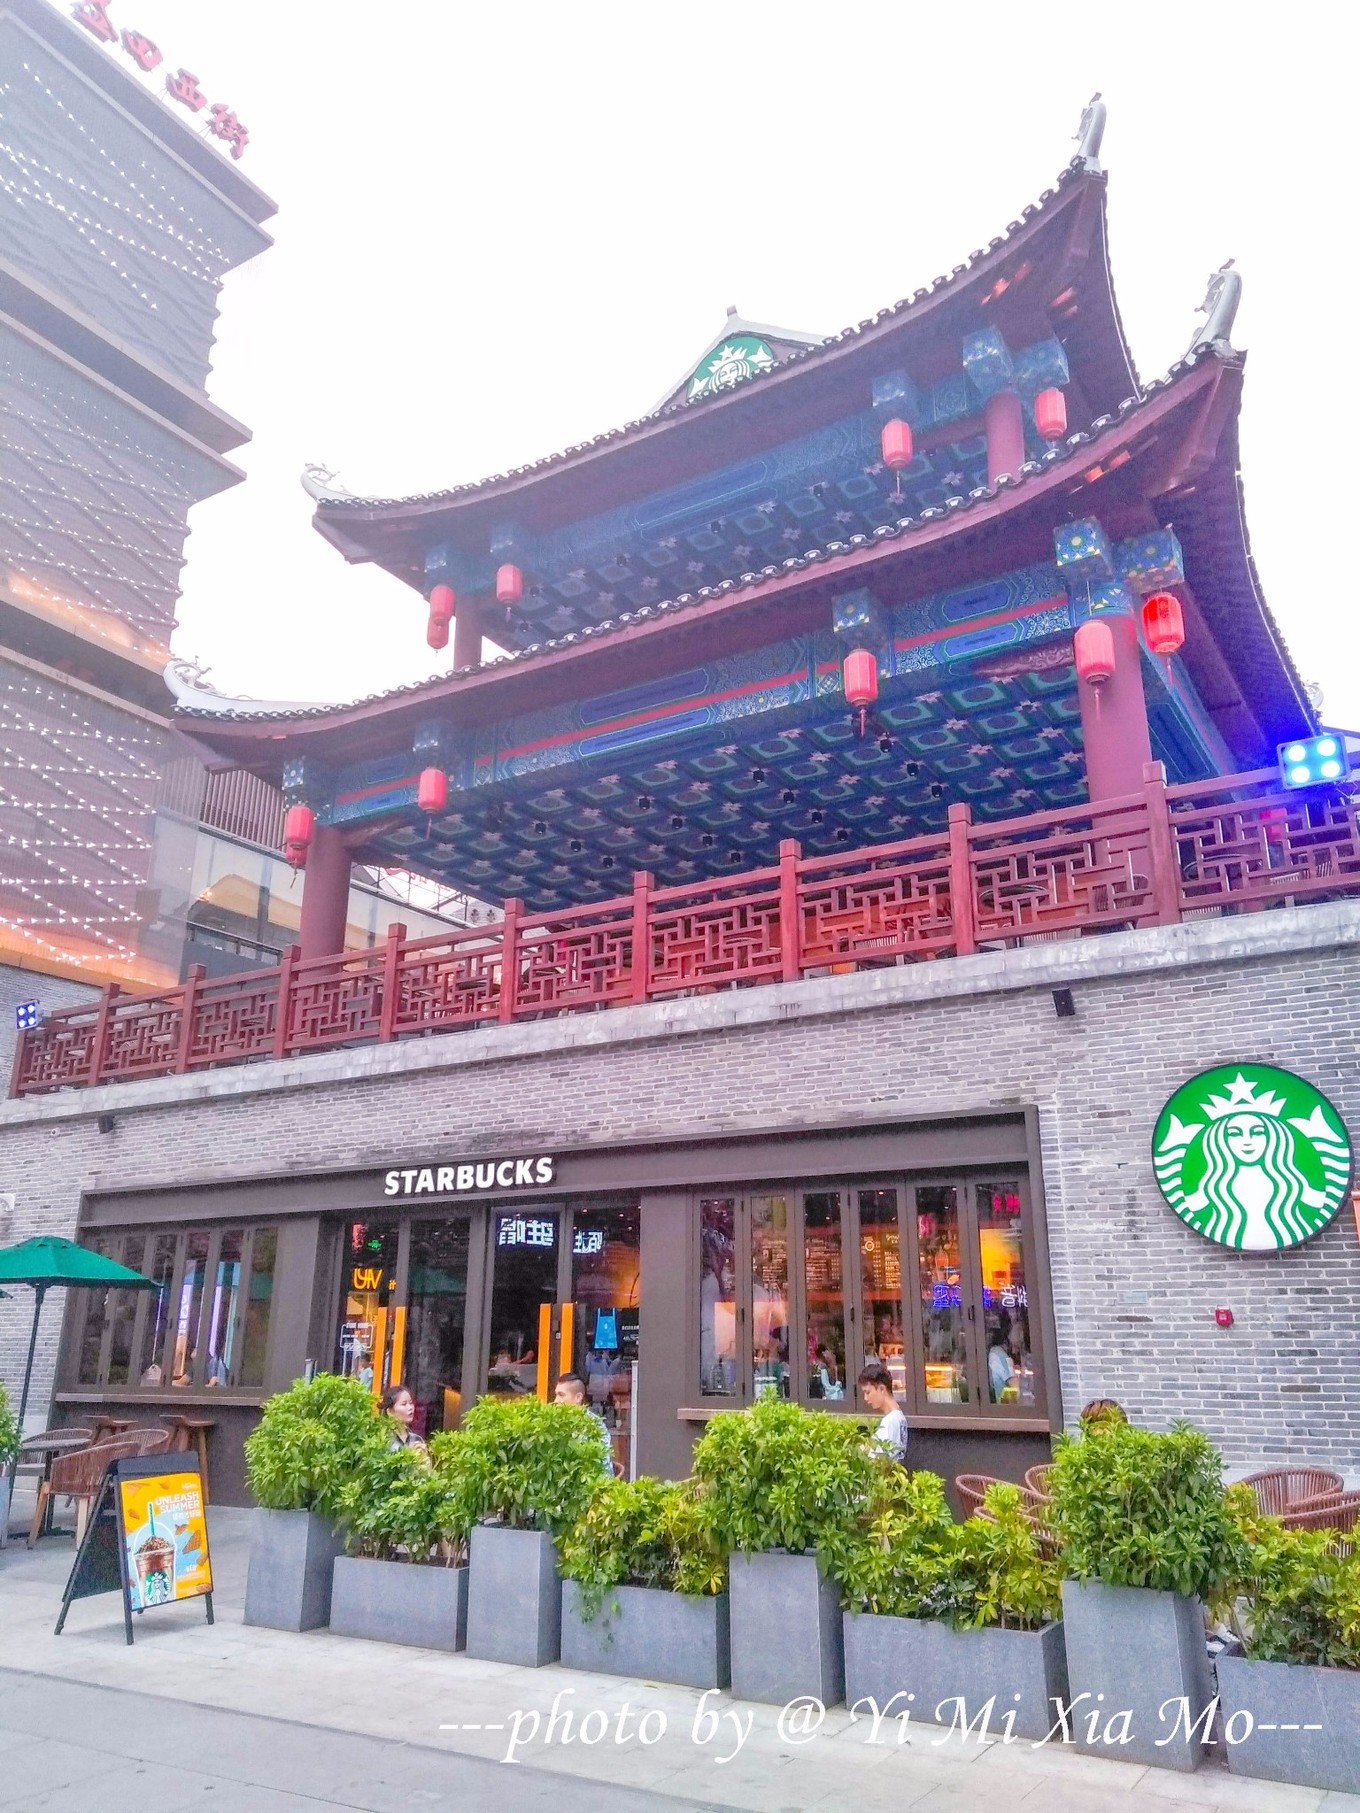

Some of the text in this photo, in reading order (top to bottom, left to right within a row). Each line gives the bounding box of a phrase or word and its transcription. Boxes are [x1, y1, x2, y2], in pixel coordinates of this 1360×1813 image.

[384, 1157, 553, 1195] STARBUCKS
[154, 1491, 199, 1506] UNLEASH
[160, 1500, 201, 1514] SUMMER
